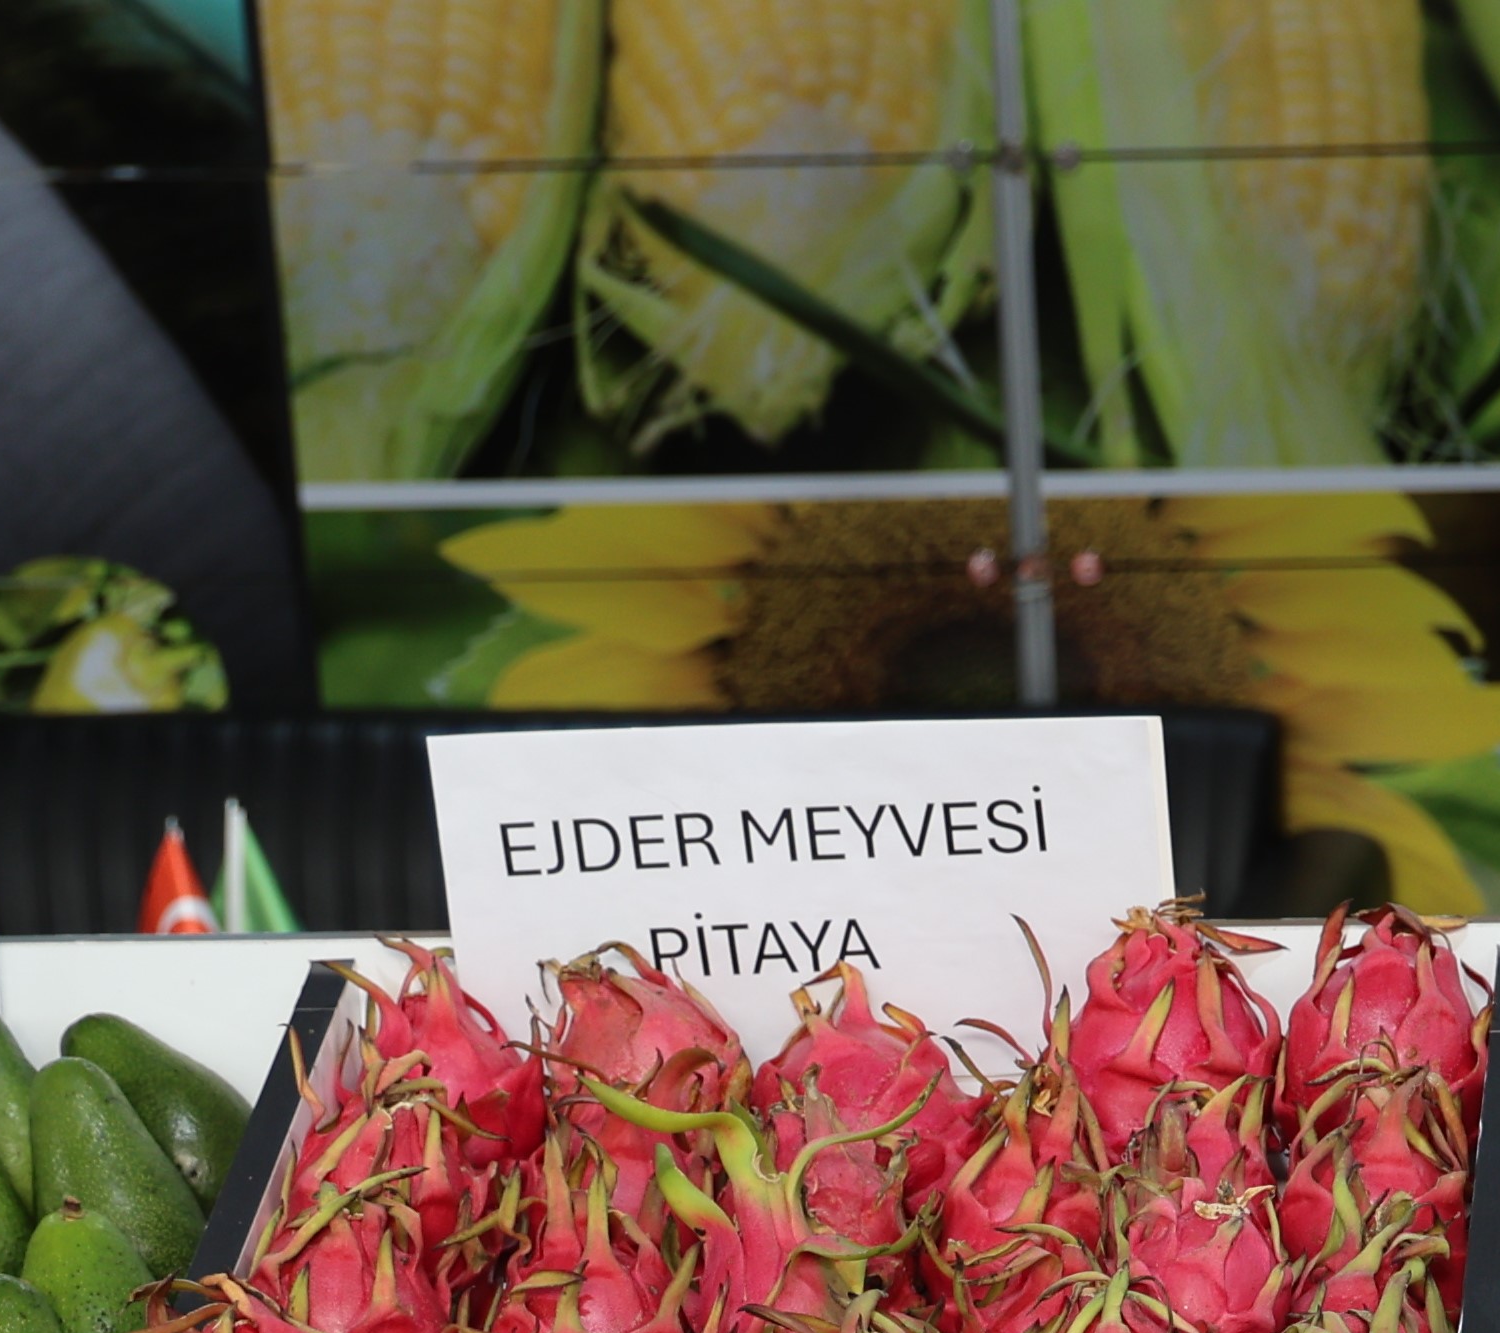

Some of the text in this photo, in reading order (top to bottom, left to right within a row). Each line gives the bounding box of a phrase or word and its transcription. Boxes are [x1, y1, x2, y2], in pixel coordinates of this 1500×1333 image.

[500, 785, 1048, 877] EJDER MEYVESİ
[649, 912, 882, 977] PİTAYA
